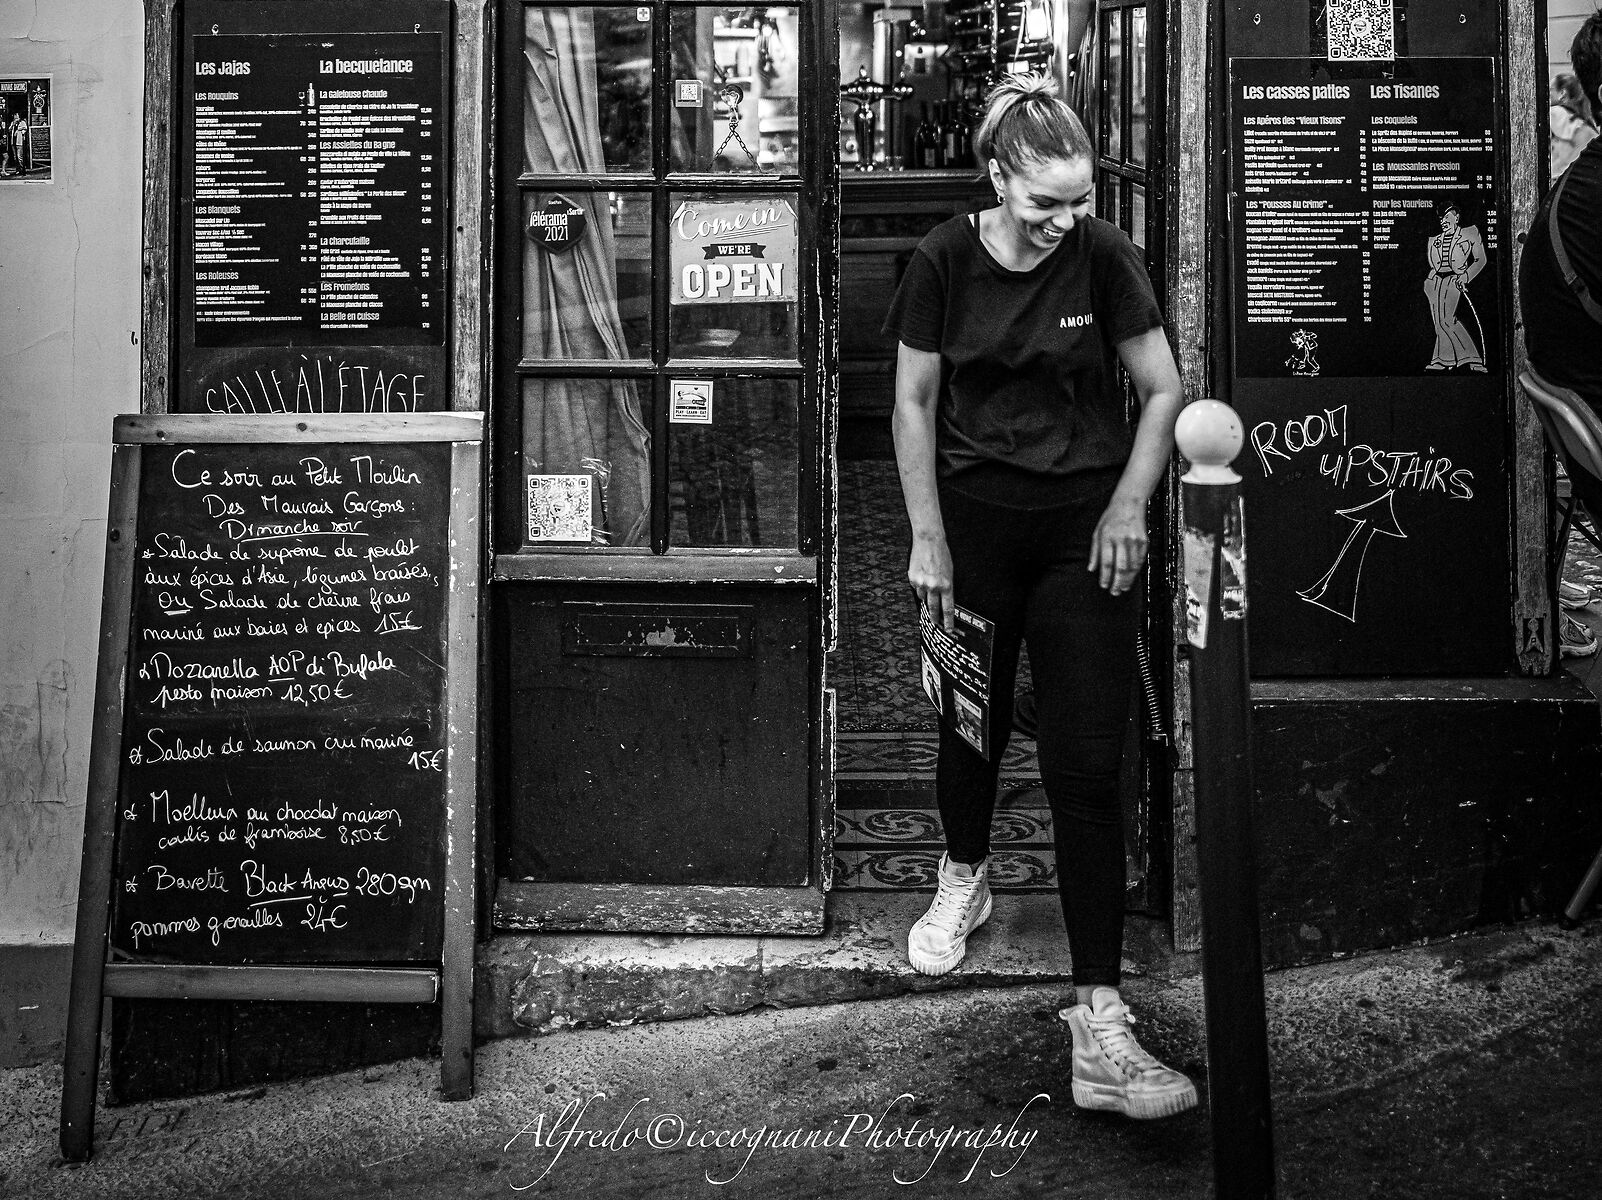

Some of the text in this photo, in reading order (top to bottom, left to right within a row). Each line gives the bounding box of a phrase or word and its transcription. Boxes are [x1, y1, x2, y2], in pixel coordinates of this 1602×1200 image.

[195, 59, 251, 76] Les Jajas
[319, 58, 413, 75] La becquetance
[195, 92, 207, 101] Les
[319, 90, 328, 99] La
[1243, 83, 1350, 101] Les casses pattes
[1370, 83, 1440, 99] Les Tisanes
[1243, 116, 1256, 125] Les
[1256, 115, 1281, 126] Apéros
[1282, 116, 1295, 125] des
[1371, 116, 1383, 125] Les
[320, 141, 331, 150] Les
[363, 141, 373, 149] du
[1372, 162, 1385, 171] Les
[1429, 161, 1460, 171] Pression
[195, 206, 207, 215] Les
[1246, 200, 1258, 209] Les
[1292, 200, 1301, 209] Au
[1373, 199, 1433, 208] Pour les Vauriens
[530, 211, 568, 226] Télérama
[677, 206, 784, 241] Come in
[320, 237, 328, 246] La
[544, 226, 569, 241] 2021
[717, 245, 752, 256] WE'RE
[195, 272, 208, 280] Les
[681, 263, 785, 300] OPEN
[320, 283, 332, 291] Les
[320, 312, 329, 321] La
[330, 311, 346, 321] Belle
[347, 312, 356, 320] en
[1250, 404, 1348, 478] ROOM
[171, 449, 422, 489] Ce soir au Petit Moulin
[202, 494, 246, 518] Des
[260, 494, 334, 514] Mauvais
[219, 517, 363, 540] Dimanche soir
[154, 532, 224, 561] Salade
[229, 542, 251, 561] de
[334, 537, 358, 558] de
[362, 537, 420, 563] poulet
[189, 565, 235, 590] épices
[301, 565, 368, 595] légumes
[158, 591, 194, 610] Ou
[199, 588, 268, 610] Salade
[277, 592, 302, 609] de
[369, 586, 411, 614] frais
[142, 621, 206, 641] mariné
[213, 624, 242, 639] aux
[247, 617, 288, 637] baies
[295, 617, 309, 634] et
[373, 610, 423, 635] 15€
[149, 649, 397, 681] Mozzarella AOP di Bufala
[150, 684, 203, 709] pesto
[210, 685, 273, 700] maison
[146, 727, 414, 764] Salade de saumon cru mariné
[407, 748, 445, 772] 15€
[246, 807, 270, 822] au
[276, 798, 339, 821] chocolat
[158, 824, 210, 850] coulis
[218, 824, 238, 843] de
[243, 821, 327, 850] framboise
[147, 864, 230, 893] Bavette
[239, 858, 298, 898] Black
[130, 902, 348, 950] pommes grenailles 24€
